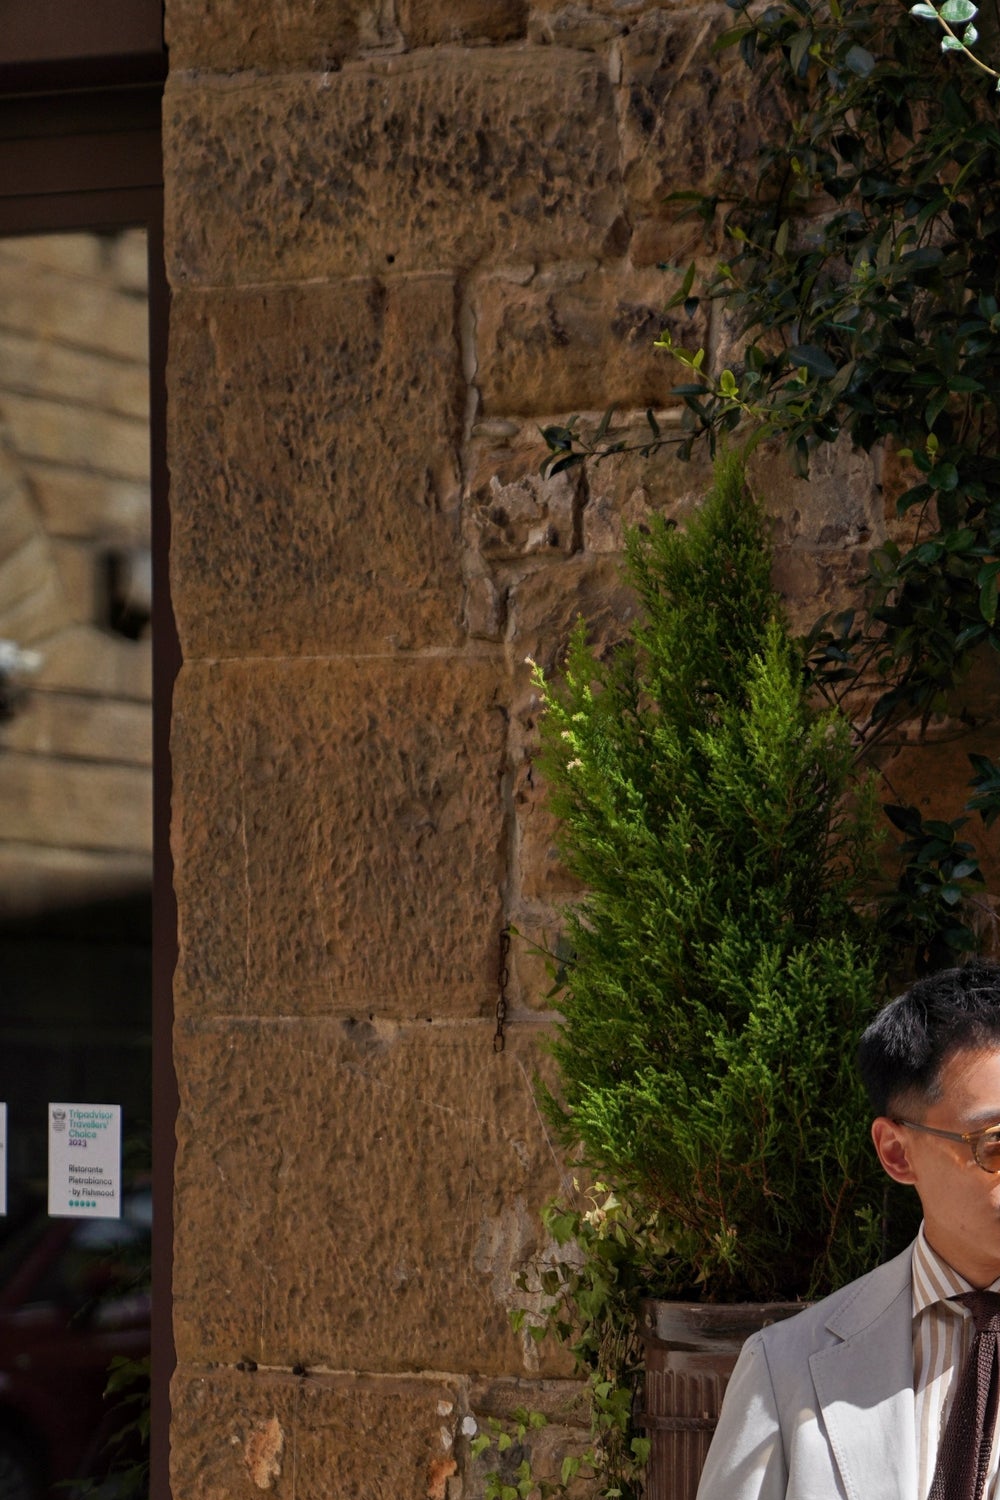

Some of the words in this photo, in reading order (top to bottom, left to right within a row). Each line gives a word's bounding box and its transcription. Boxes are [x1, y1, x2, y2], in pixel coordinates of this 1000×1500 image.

[69, 1109, 112, 1120] Tripadvisor
[68, 1129, 97, 1138] Choice
[68, 1139, 87, 1147] 2023
[68, 1164, 103, 1173] Ristorante
[68, 1176, 112, 1185] Pietrabianca
[72, 1188, 81, 1197] by
